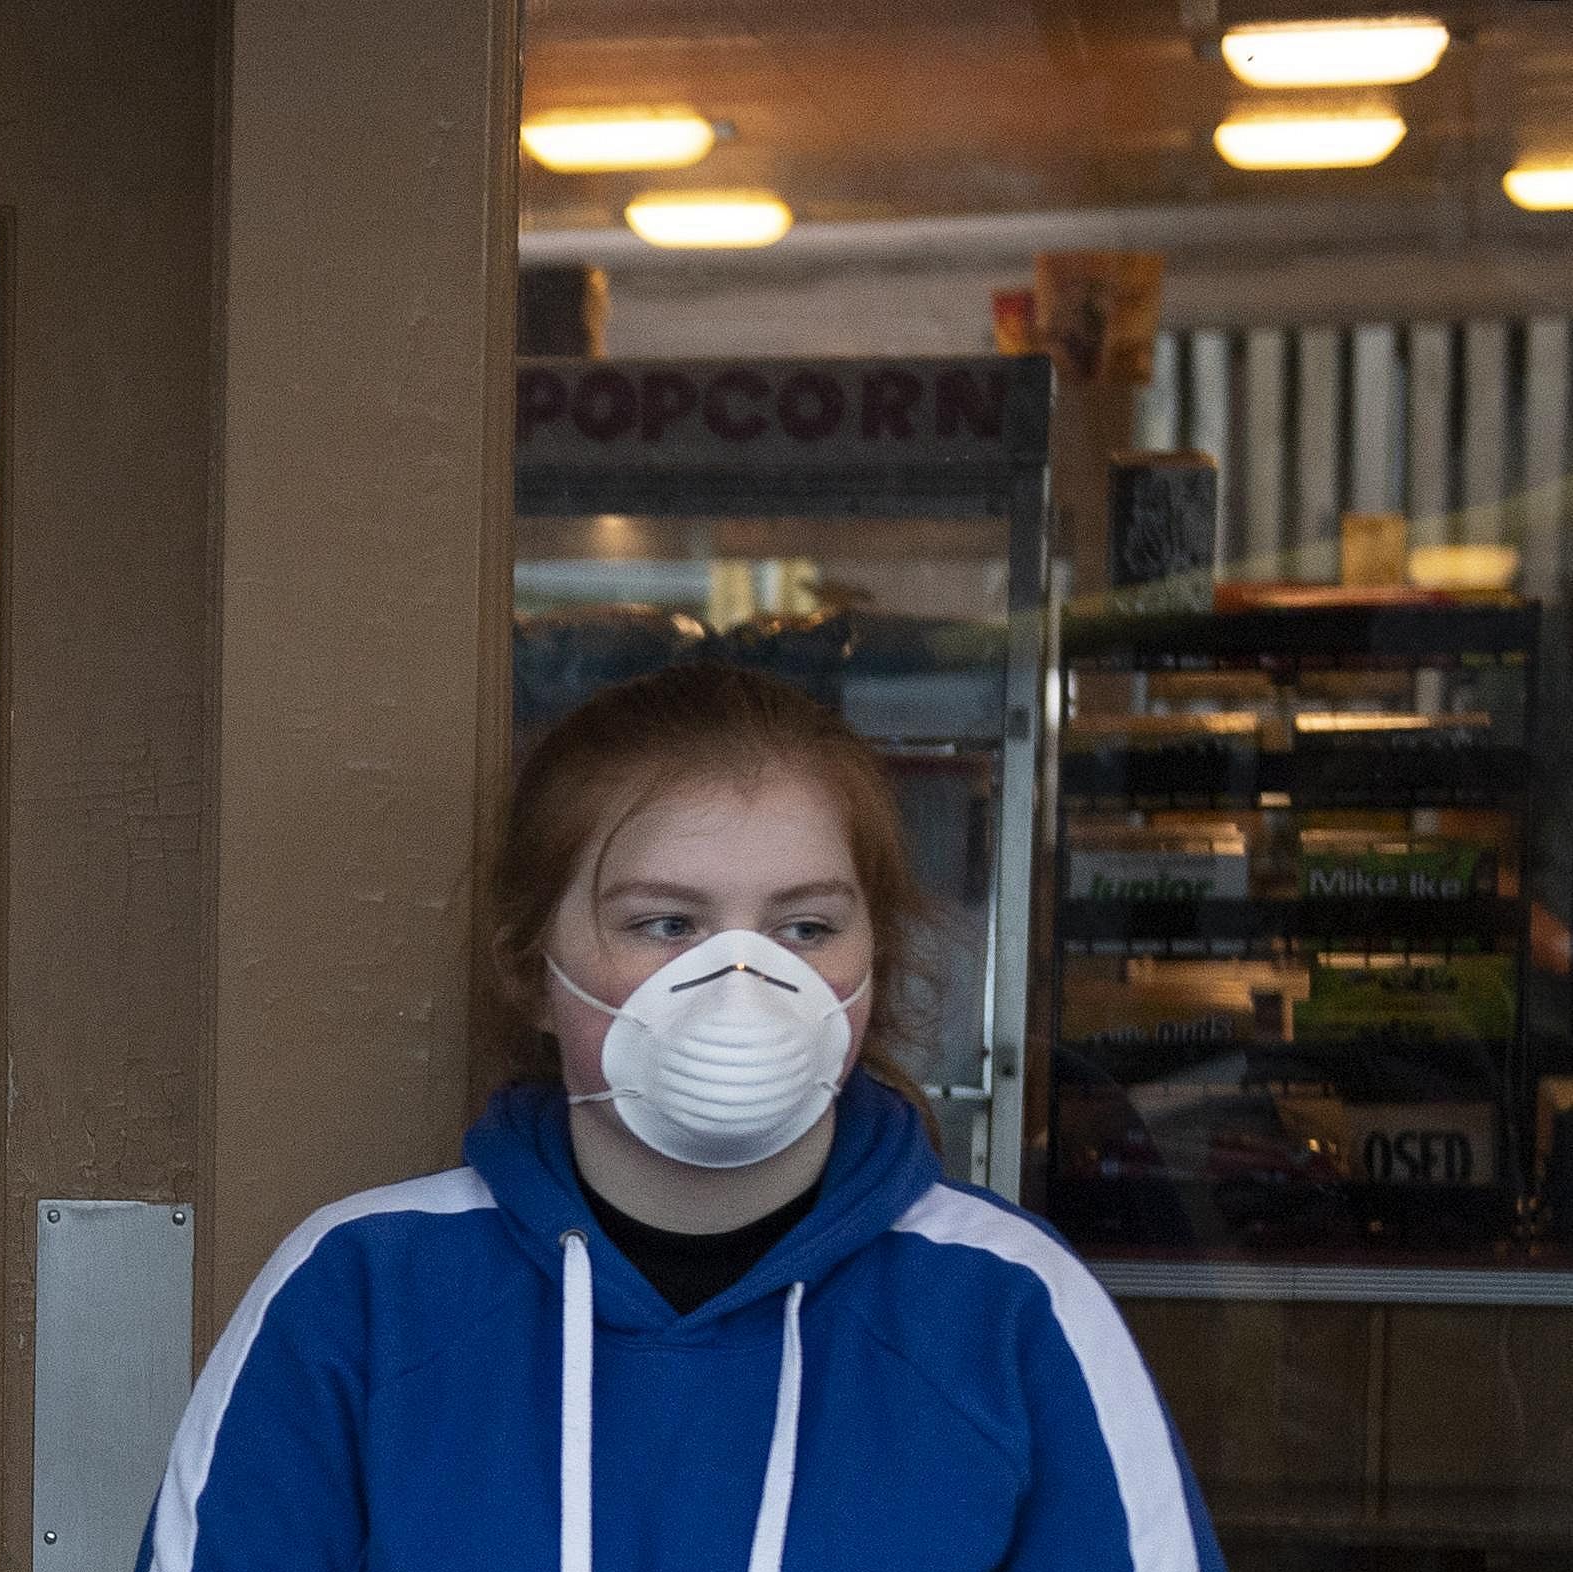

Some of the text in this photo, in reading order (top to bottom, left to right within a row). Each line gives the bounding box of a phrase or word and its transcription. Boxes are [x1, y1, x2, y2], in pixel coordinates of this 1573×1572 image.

[515, 367, 1007, 442] POPCORN
[1308, 866, 1462, 899] Mike Ike
